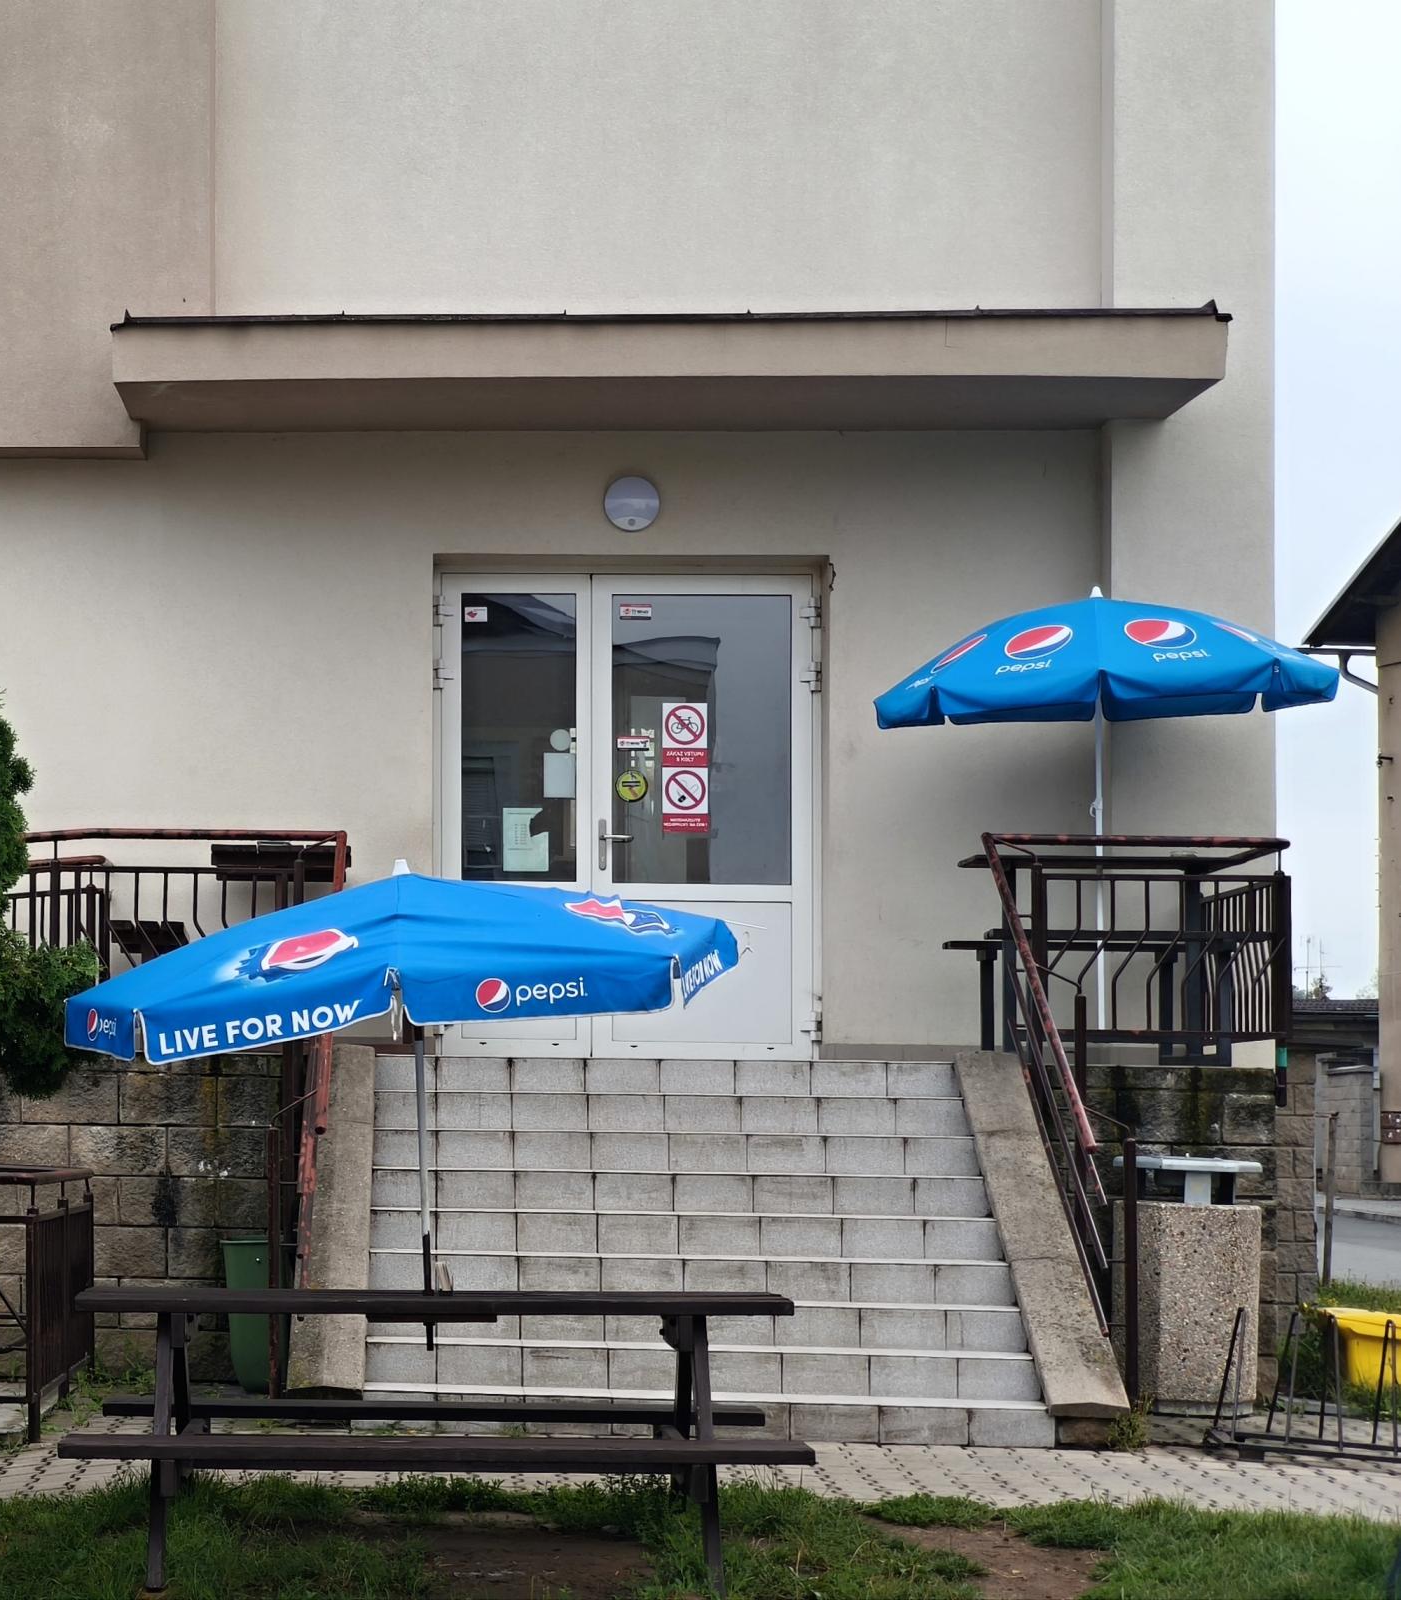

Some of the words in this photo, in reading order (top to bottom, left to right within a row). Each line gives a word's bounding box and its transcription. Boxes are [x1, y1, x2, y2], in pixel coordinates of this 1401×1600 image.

[995, 659, 1052, 675] pepsi
[1152, 649, 1208, 663] pepsi
[515, 976, 585, 1006] pepsi
[158, 1025, 219, 1056] LIVE
[226, 1013, 283, 1044] FOR
[290, 999, 362, 1034] NOW
